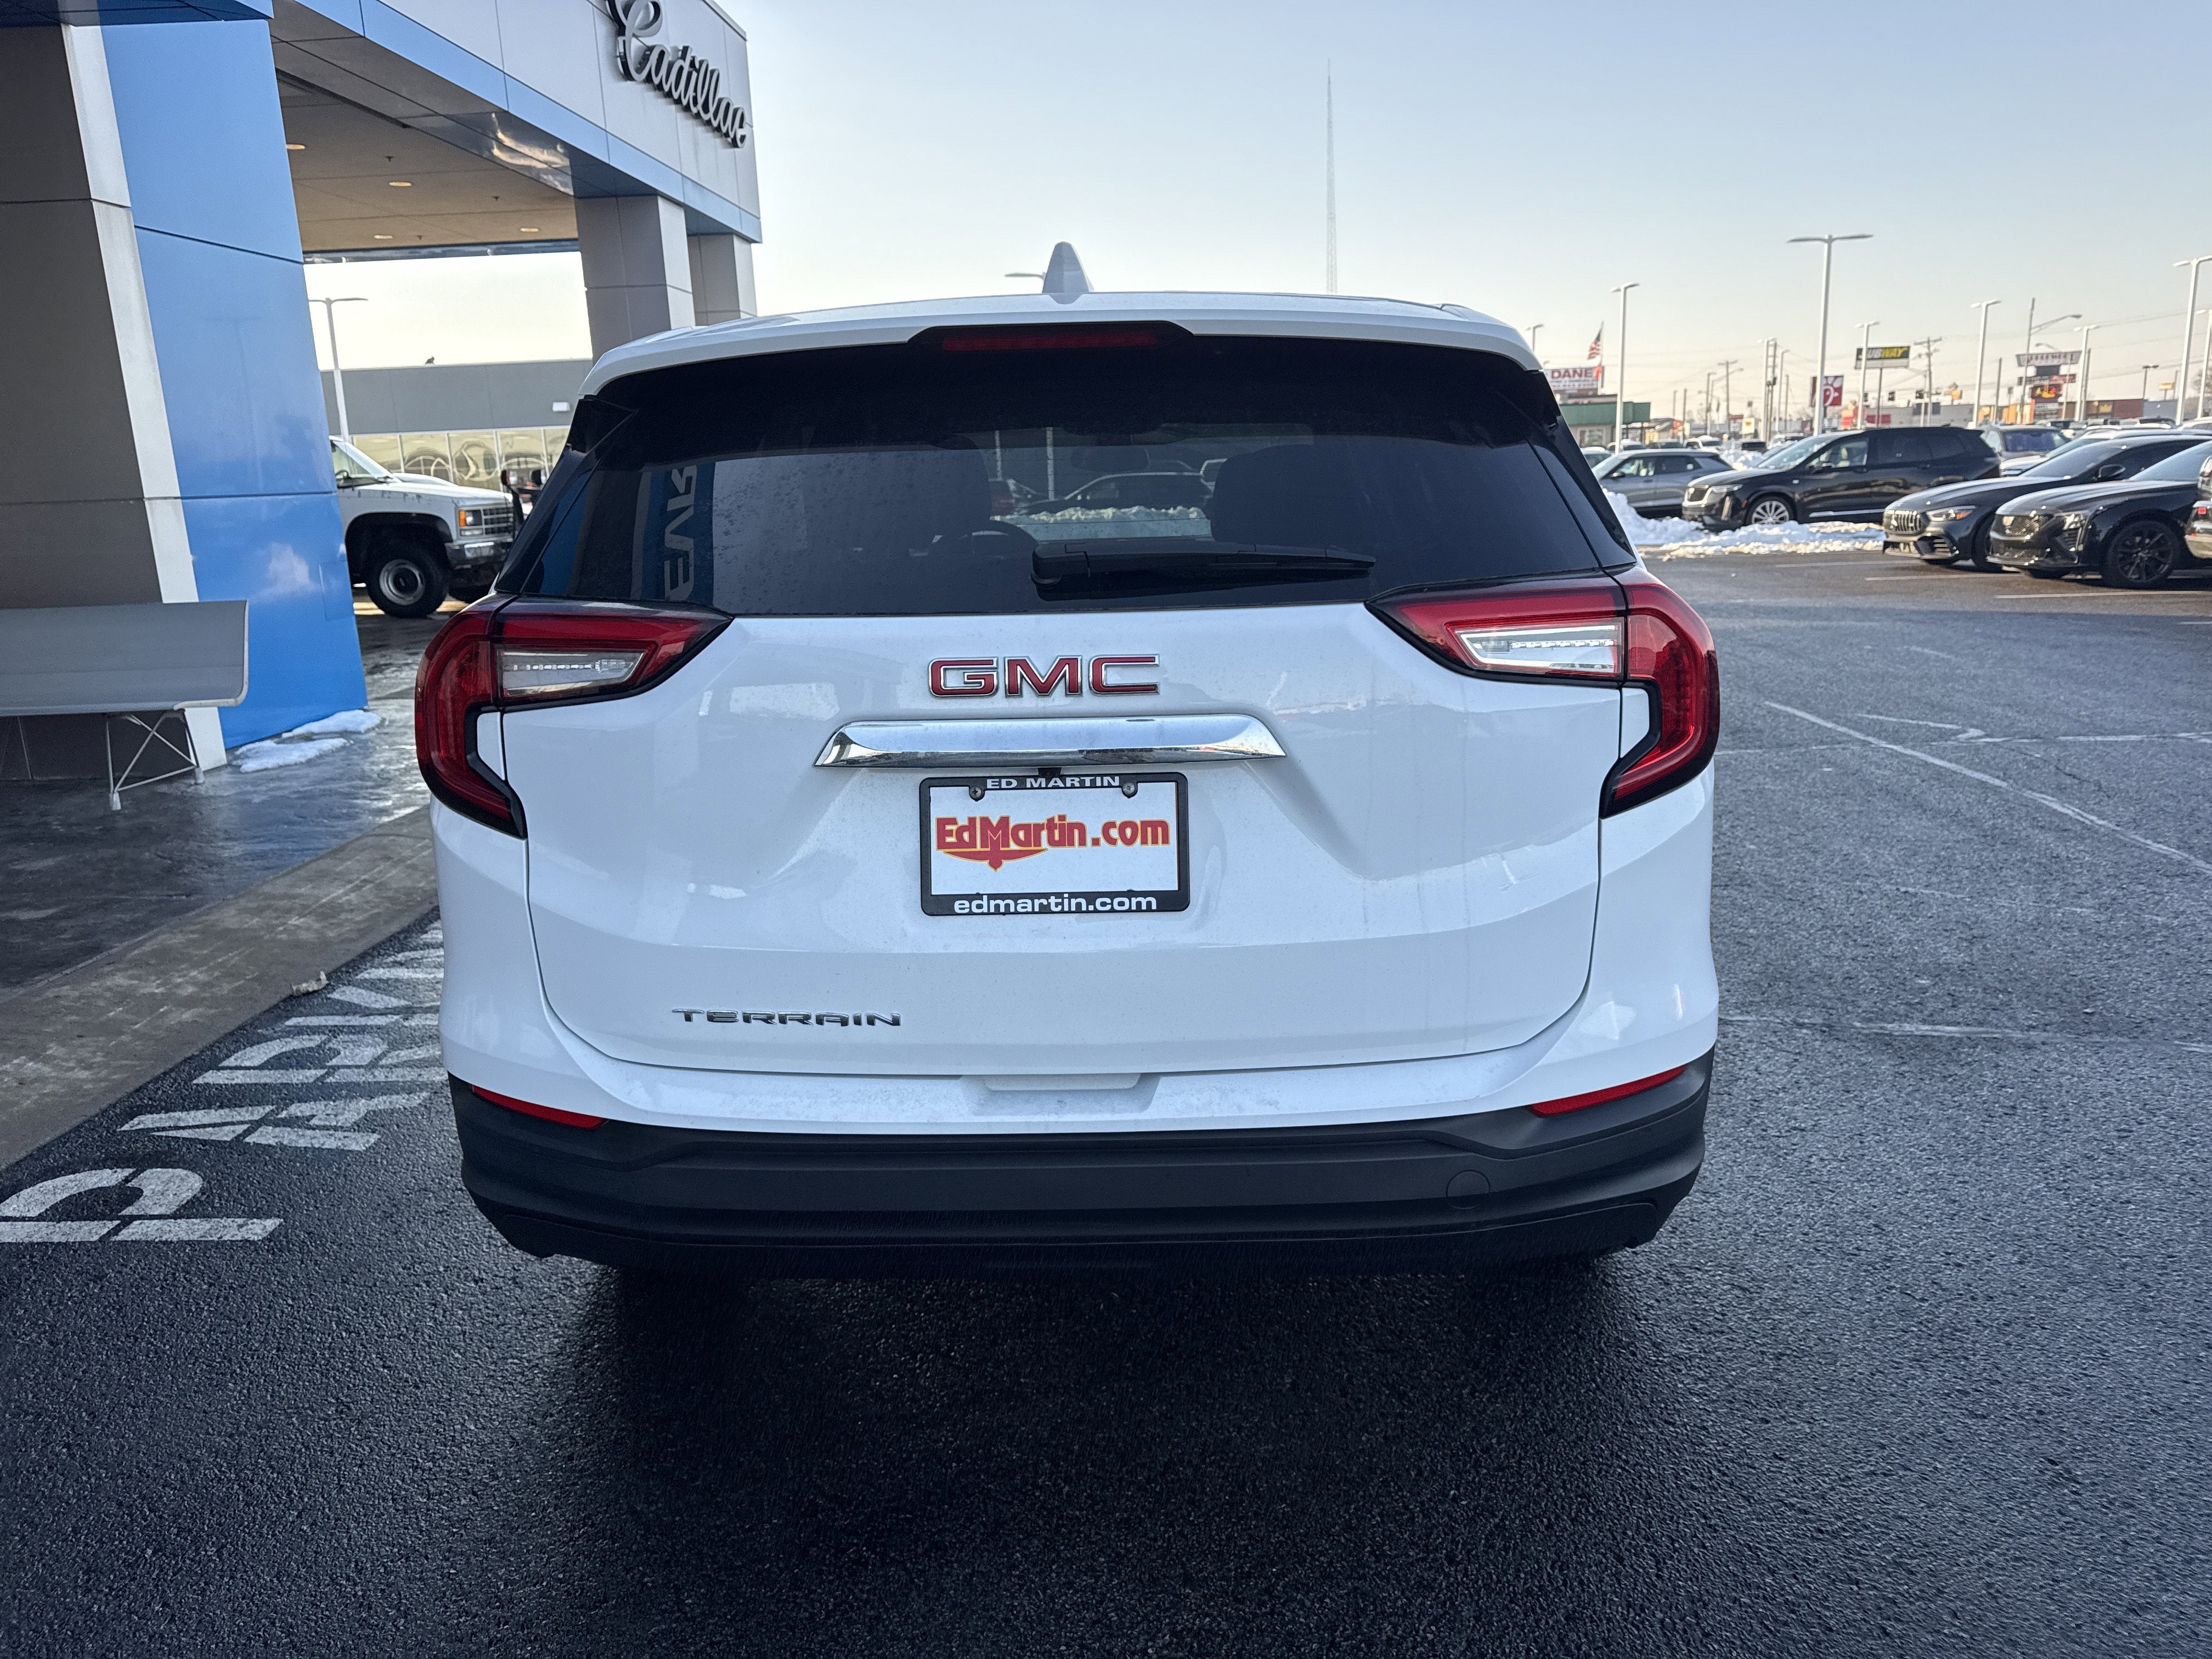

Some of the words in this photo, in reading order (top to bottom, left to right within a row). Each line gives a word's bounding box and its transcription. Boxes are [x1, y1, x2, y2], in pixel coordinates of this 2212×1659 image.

[605, 0, 747, 149] Cadillac
[1858, 347, 1909, 359] UBWAY
[927, 653, 1161, 697] GMC
[986, 778, 1018, 789] ED
[1026, 776, 1120, 788] MARTIN
[935, 814, 1171, 850] EdMartin.com
[953, 893, 1158, 913] edmartin.com
[671, 1008, 901, 1027] TERRAIN
